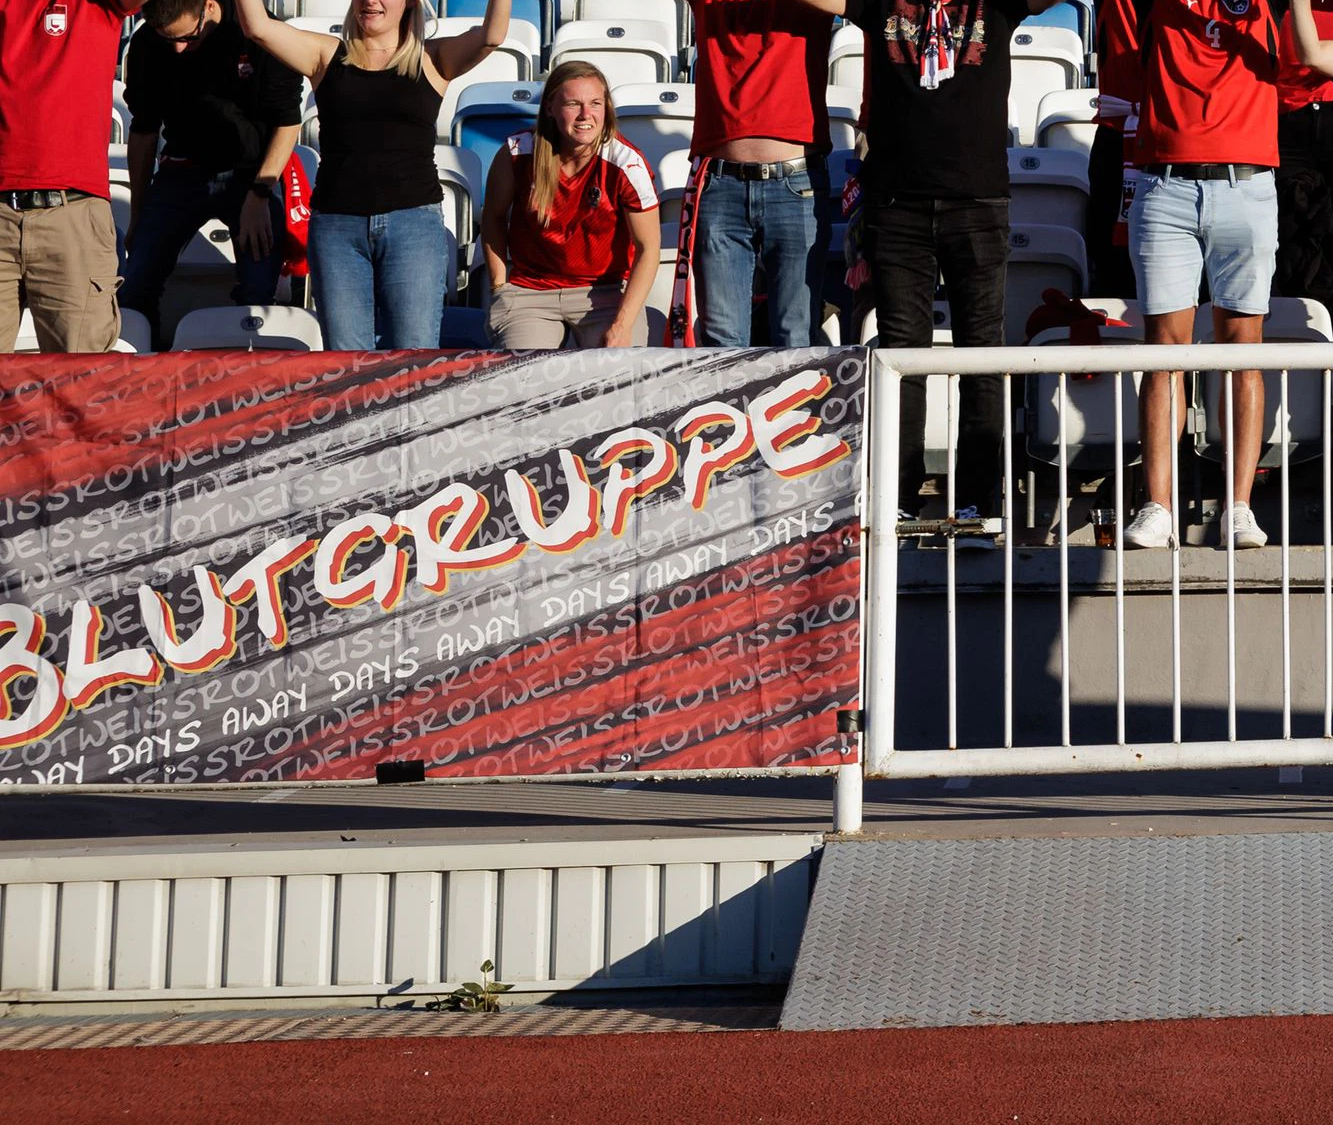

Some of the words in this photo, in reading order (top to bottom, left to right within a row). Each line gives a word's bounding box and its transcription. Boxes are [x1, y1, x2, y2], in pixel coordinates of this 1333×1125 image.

[0, 370, 852, 747] BLUTGRUPPE
[107, 719, 202, 775] DAYS
[222, 683, 309, 736] AWAY
[329, 645, 421, 702] DAYS
[437, 609, 521, 661] AWAY
[541, 571, 631, 628] DAYS
[645, 538, 729, 589] AWAY
[748, 501, 835, 556] DAYS
